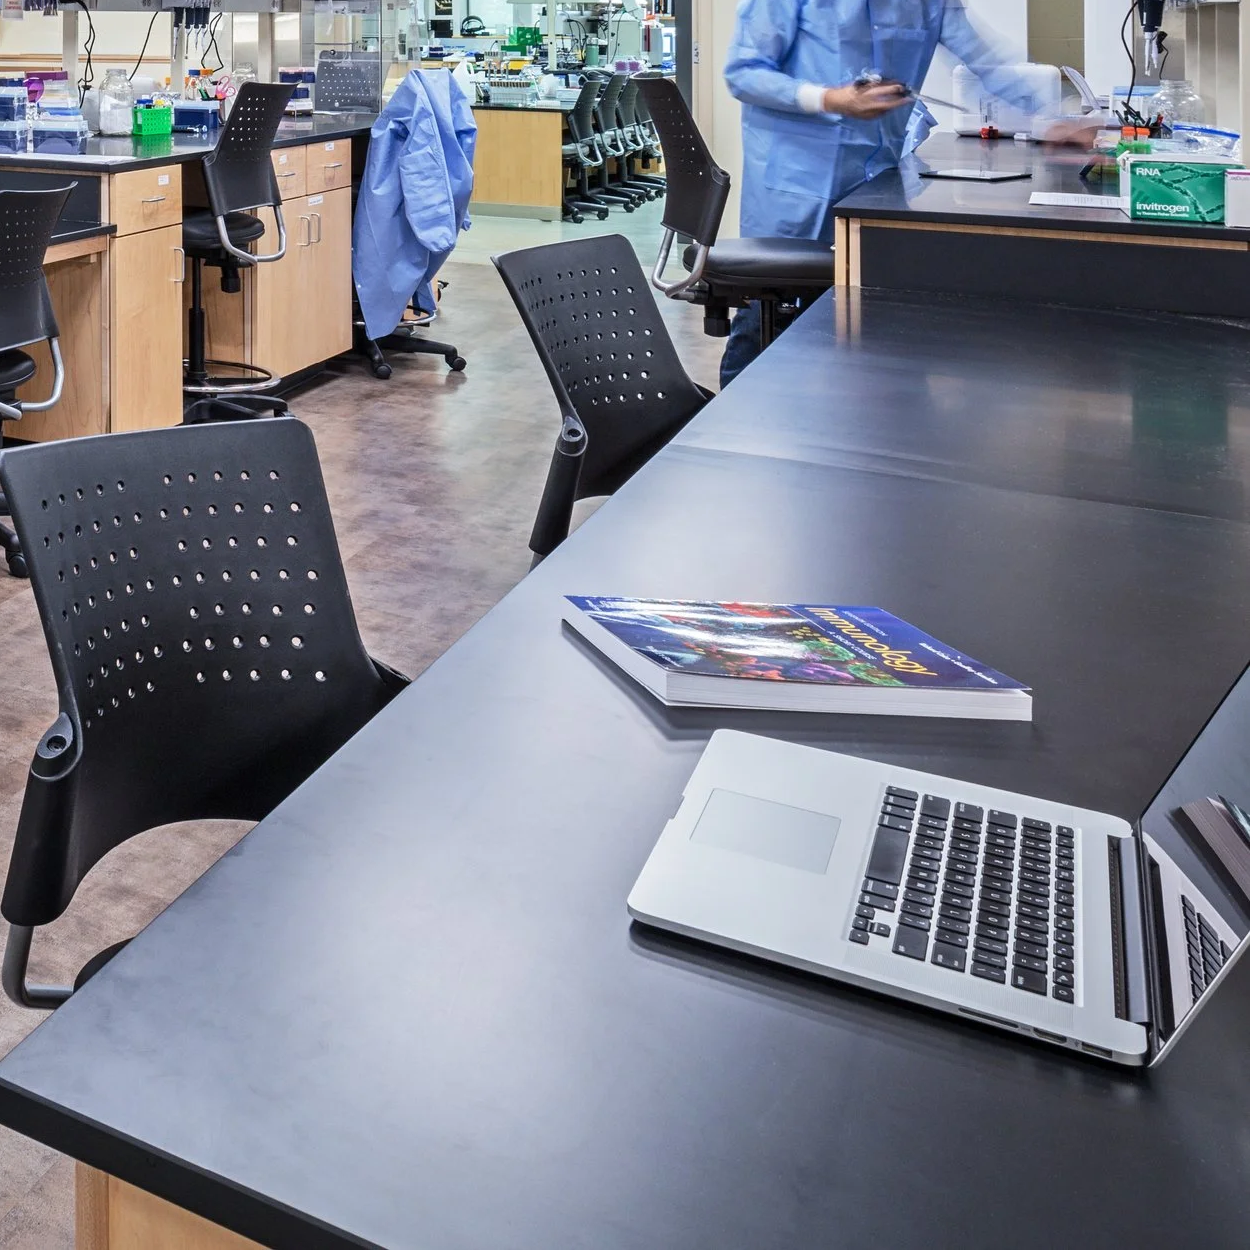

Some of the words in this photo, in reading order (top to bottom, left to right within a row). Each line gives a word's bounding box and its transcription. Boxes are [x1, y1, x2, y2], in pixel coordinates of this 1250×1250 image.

[1136, 167, 1161, 176] RNA
[1136, 202, 1190, 213] invitrogen
[804, 607, 939, 676] Immunology
